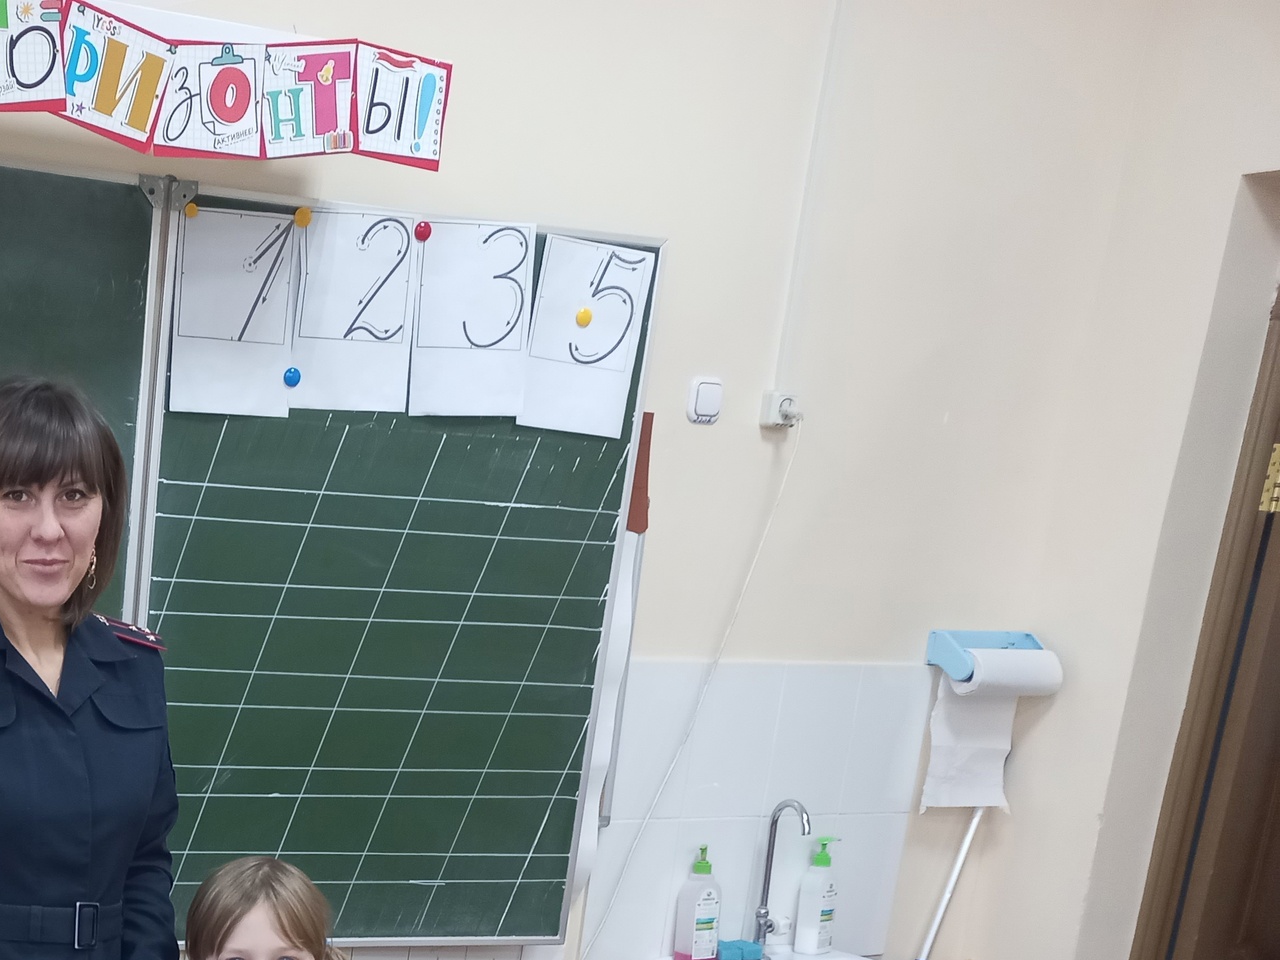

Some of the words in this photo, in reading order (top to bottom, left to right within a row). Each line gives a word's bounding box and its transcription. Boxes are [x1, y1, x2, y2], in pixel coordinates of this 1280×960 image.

[238, 219, 295, 342] 1
[344, 217, 410, 340] 2
[463, 226, 528, 348] 3
[569, 250, 647, 365] 5
